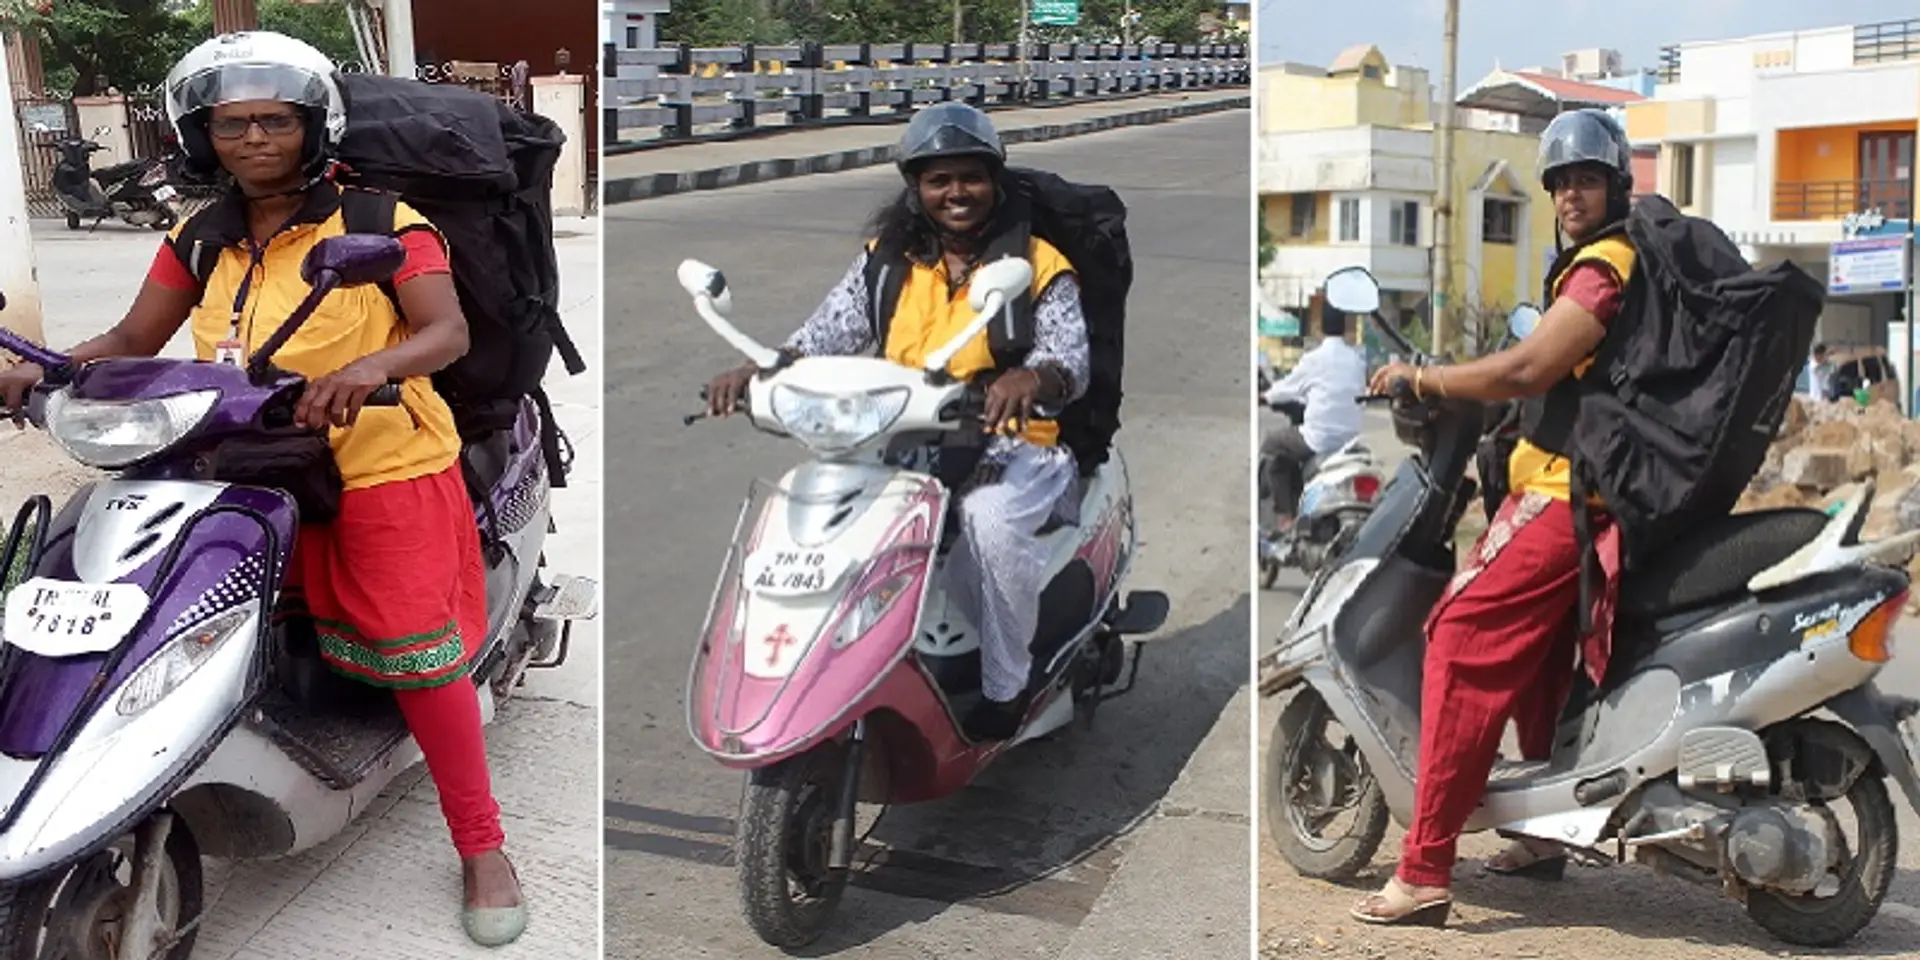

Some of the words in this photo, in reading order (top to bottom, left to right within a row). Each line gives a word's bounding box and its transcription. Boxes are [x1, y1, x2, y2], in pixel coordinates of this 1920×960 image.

[775, 551, 799, 566] TN
[805, 551, 825, 567] 10
[754, 572, 776, 587] AL
